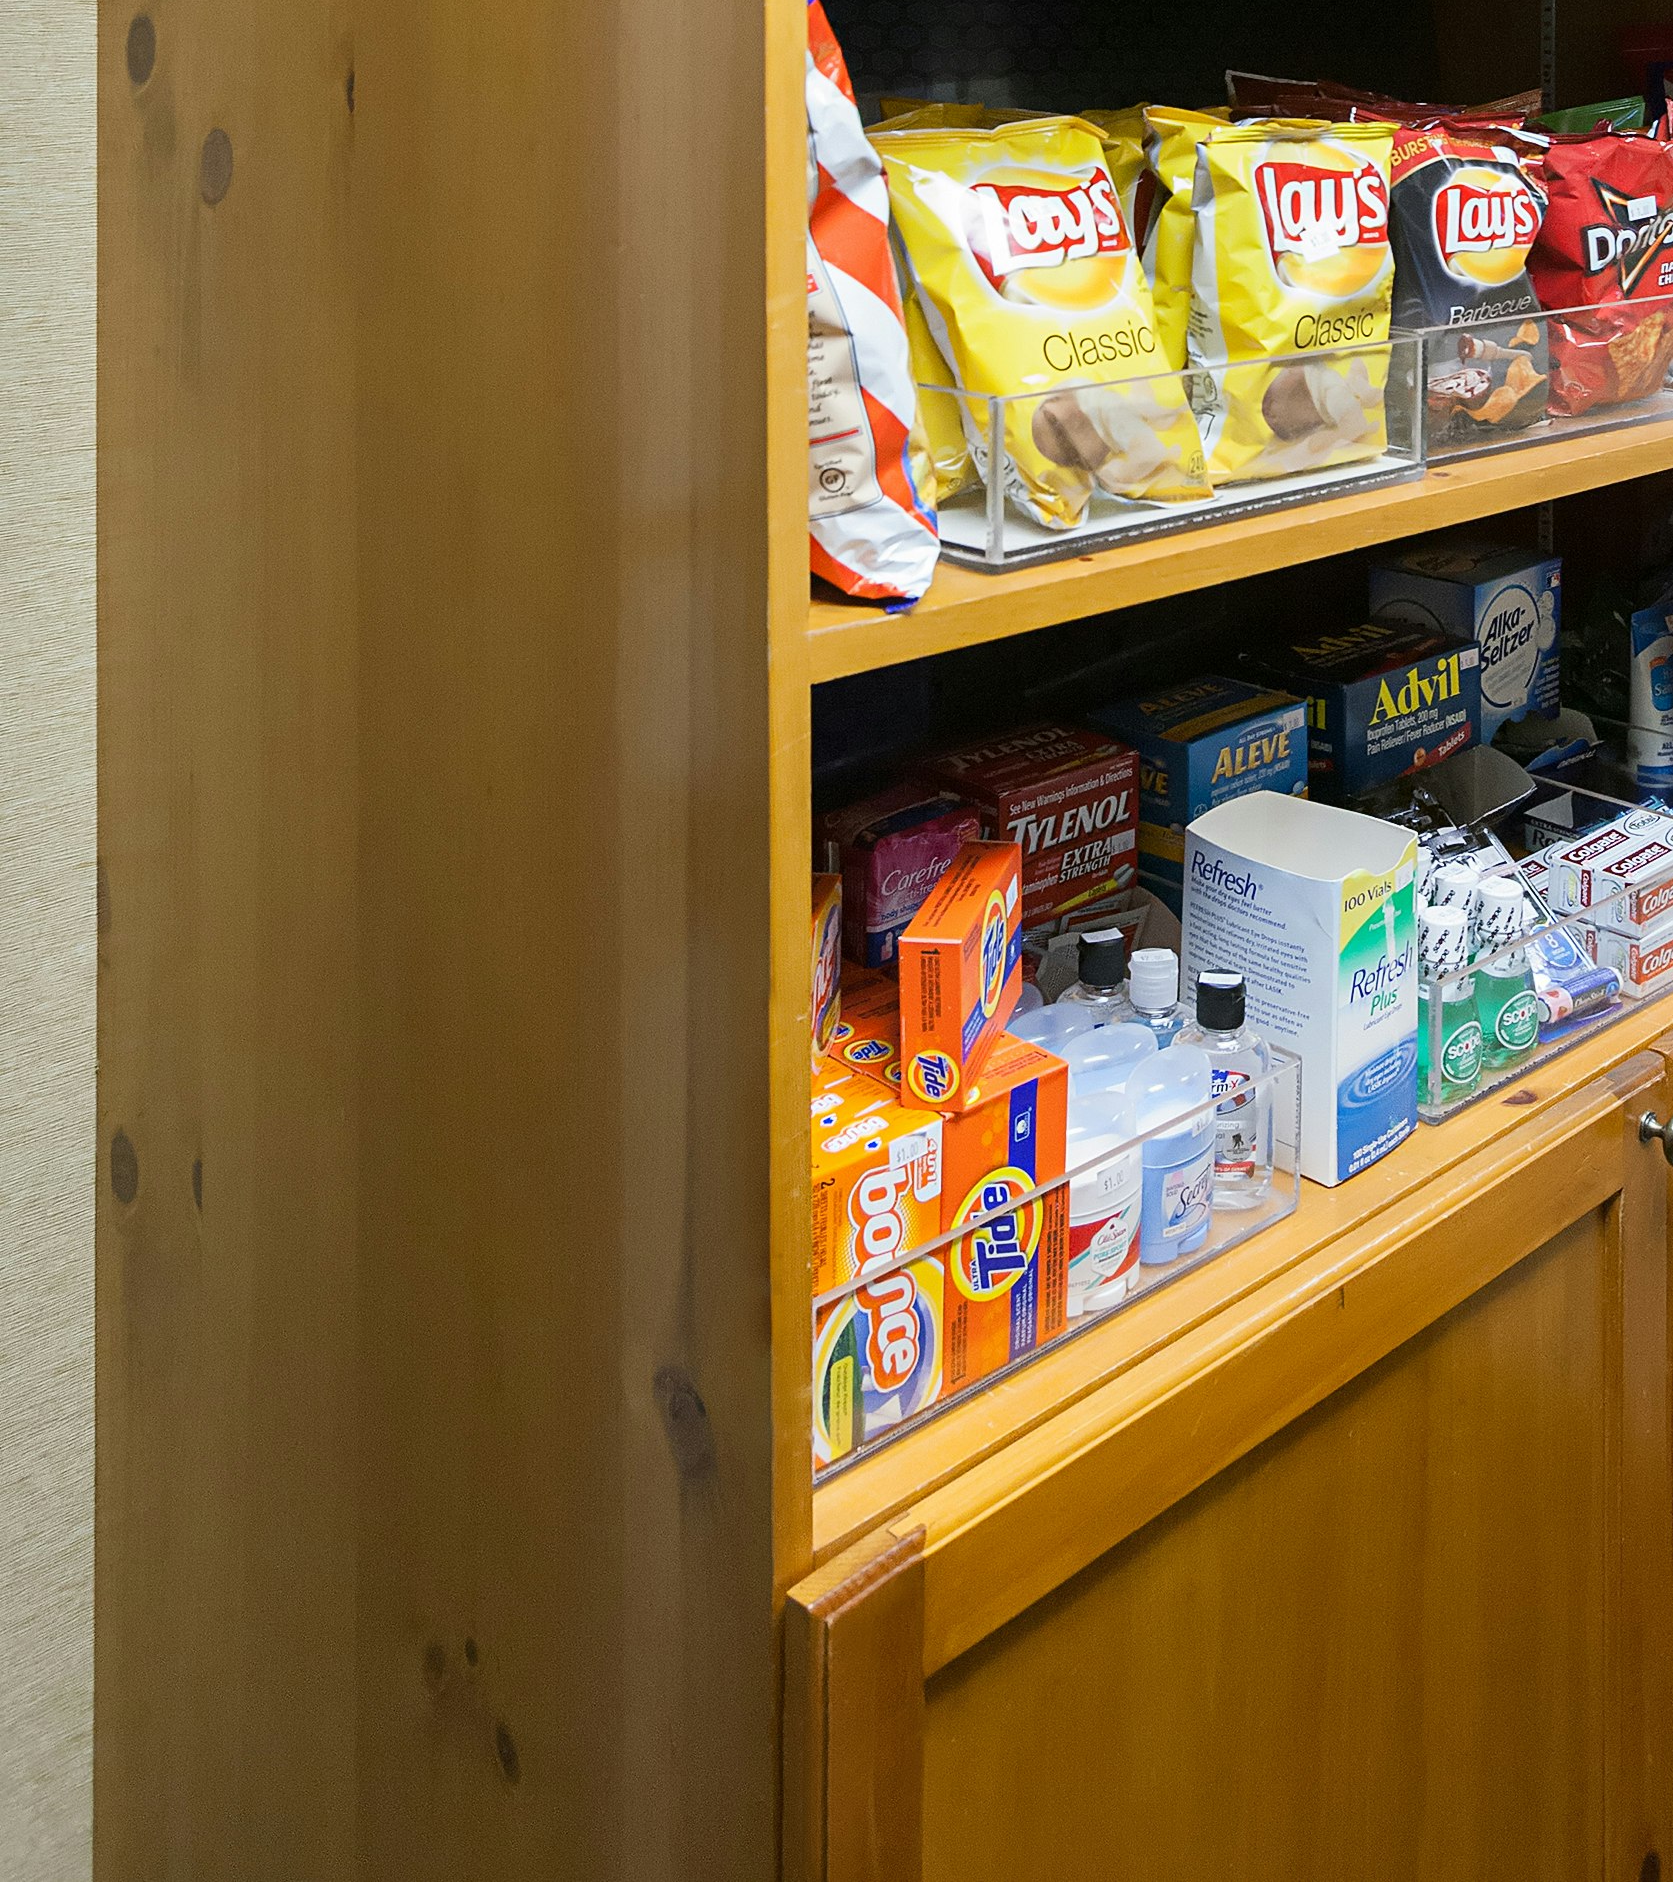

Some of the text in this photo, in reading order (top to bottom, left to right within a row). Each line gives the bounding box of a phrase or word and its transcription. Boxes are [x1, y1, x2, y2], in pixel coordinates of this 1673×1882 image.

[979, 174, 1124, 278] Lay's
[1263, 163, 1389, 254] Lay's
[1444, 188, 1536, 254] Lay's
[1294, 306, 1375, 349] Classic
[1449, 294, 1532, 327] Barbecue
[1043, 319, 1157, 373] Classic
[1480, 620, 1535, 674] Seltzer
[1483, 606, 1527, 648] Alka-
[1368, 653, 1462, 726] Advil
[1211, 730, 1292, 785] ALEVE
[1367, 741, 1381, 756] Pain
[1437, 730, 1466, 757] Tablets
[1009, 767, 1133, 816] See New Warnings Information Directions
[1007, 789, 1131, 856] TYLENOL
[1058, 854, 1111, 884] STRENGTH
[1061, 836, 1112, 872] EXTRA
[1567, 830, 1624, 866] Colgate
[1610, 843, 1665, 878] Colgate
[1191, 850, 1258, 901] Refresh
[1344, 880, 1393, 913] 100 Vials
[1350, 940, 1413, 1004] Refresh
[1370, 989, 1399, 1016] Plus
[1503, 1000, 1538, 1027] scope
[1448, 1029, 1481, 1061] scope
[916, 1055, 949, 1098] Tide
[976, 1183, 1029, 1290] Tide
